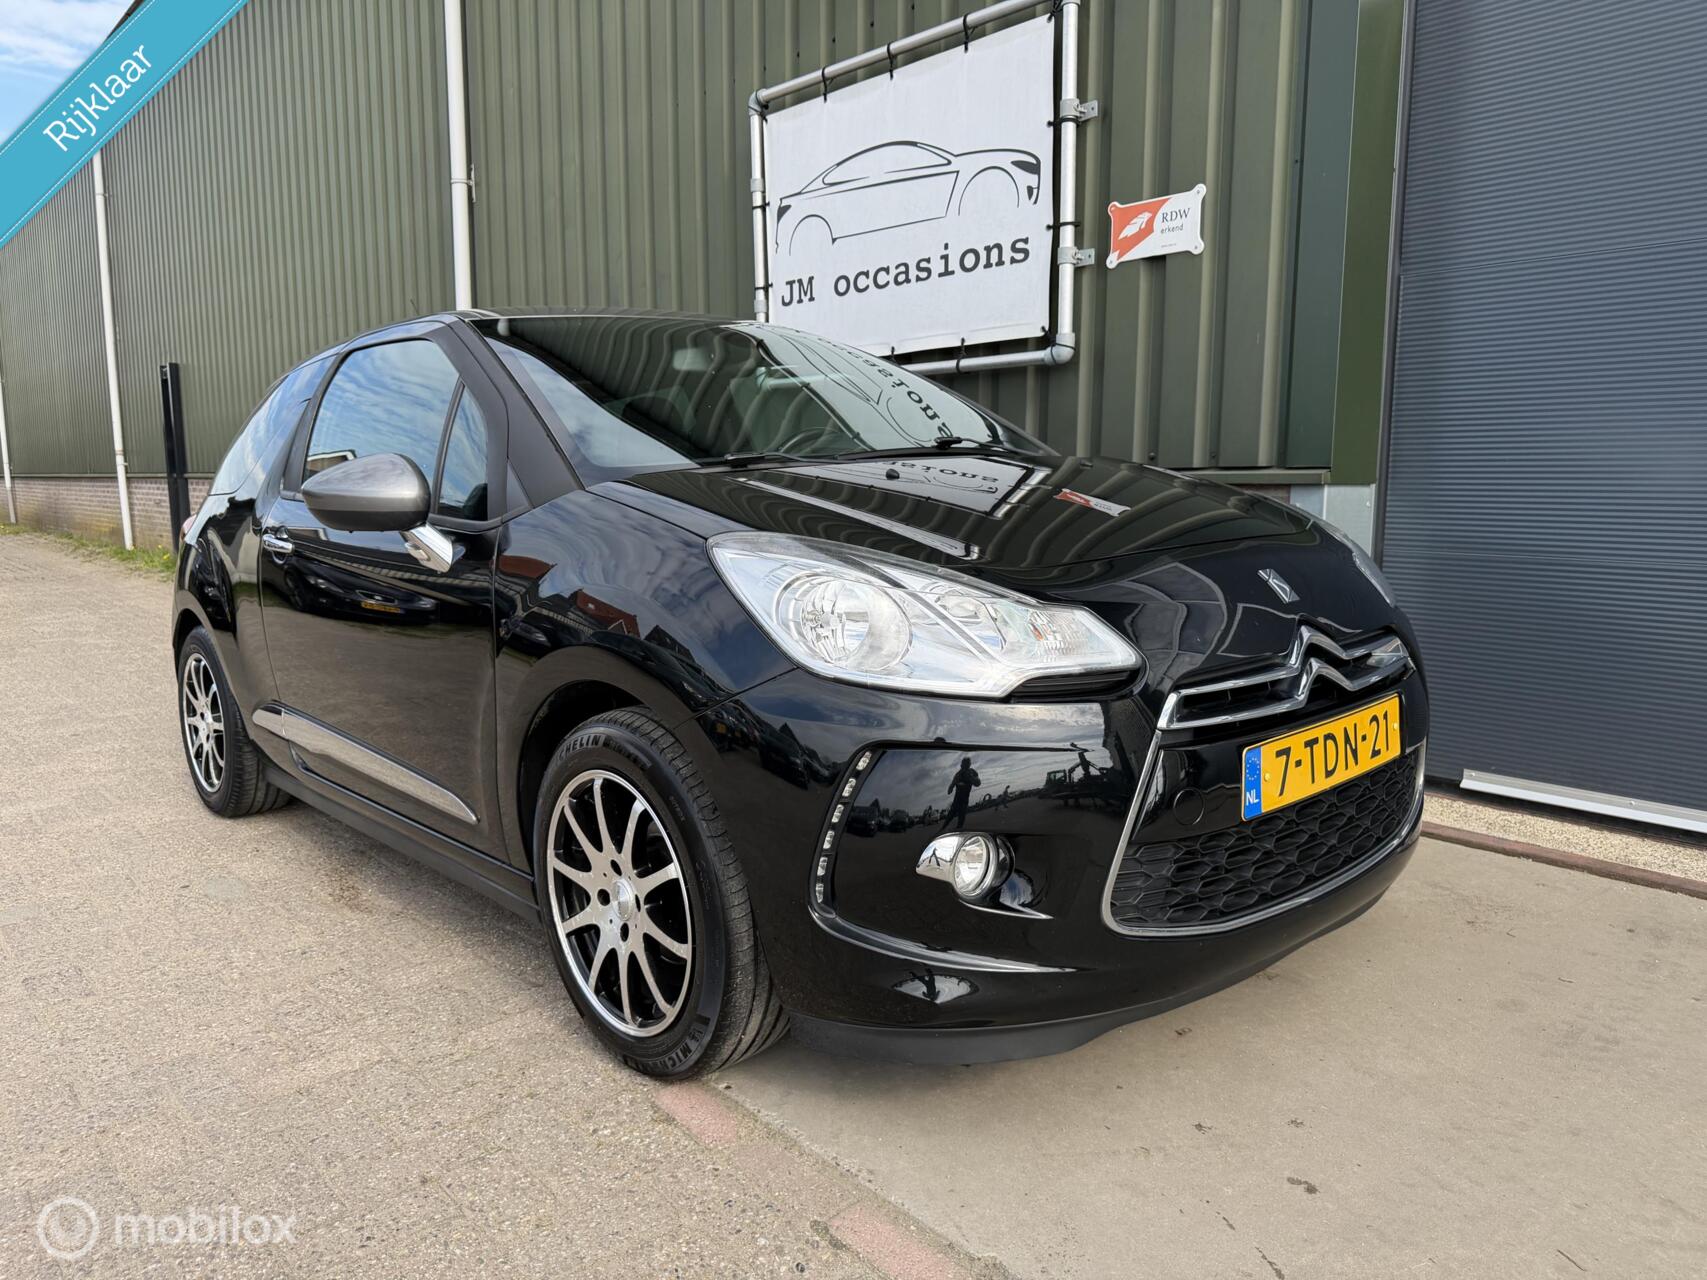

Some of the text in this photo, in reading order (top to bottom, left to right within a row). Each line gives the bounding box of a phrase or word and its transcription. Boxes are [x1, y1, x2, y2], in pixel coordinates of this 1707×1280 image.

[1162, 208, 1190, 222] RDW
[1161, 224, 1184, 234] erkend
[781, 237, 1030, 307] JM occasions
[1275, 709, 1390, 797] 7-TDN-21
[1245, 789, 1260, 806] NL
